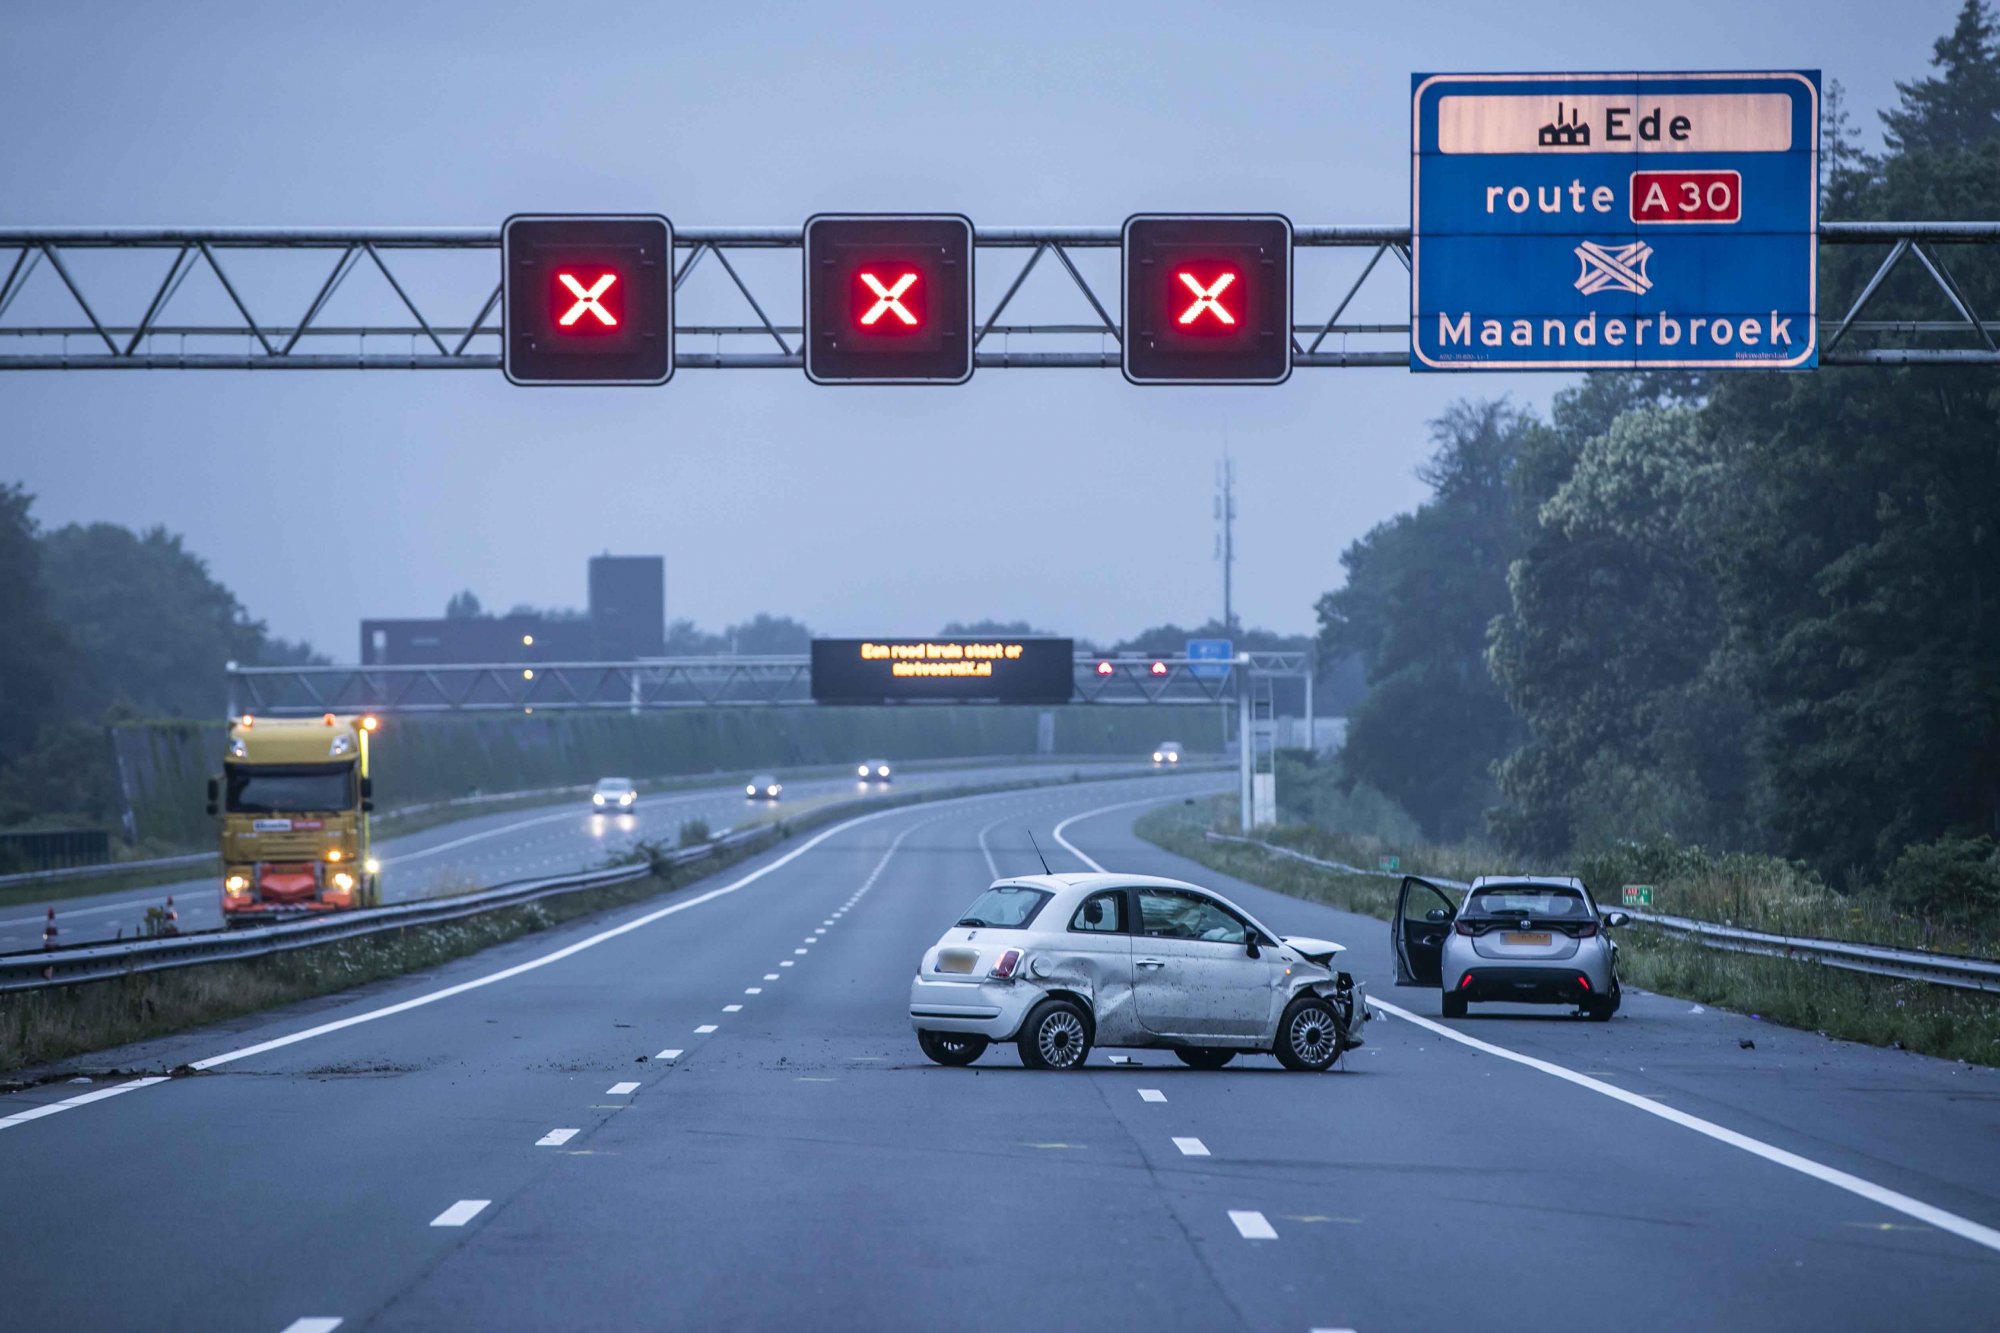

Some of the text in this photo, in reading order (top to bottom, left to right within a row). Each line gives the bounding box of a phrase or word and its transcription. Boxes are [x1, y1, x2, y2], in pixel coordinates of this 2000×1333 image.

[1605, 107, 1692, 142] Ede
[1486, 178, 1614, 213] route
[1438, 310, 1793, 347] Maanderbroek
[1735, 351, 1788, 360] Rijkswaterstaat
[861, 642, 1024, 660] Een rood kruis staat er
